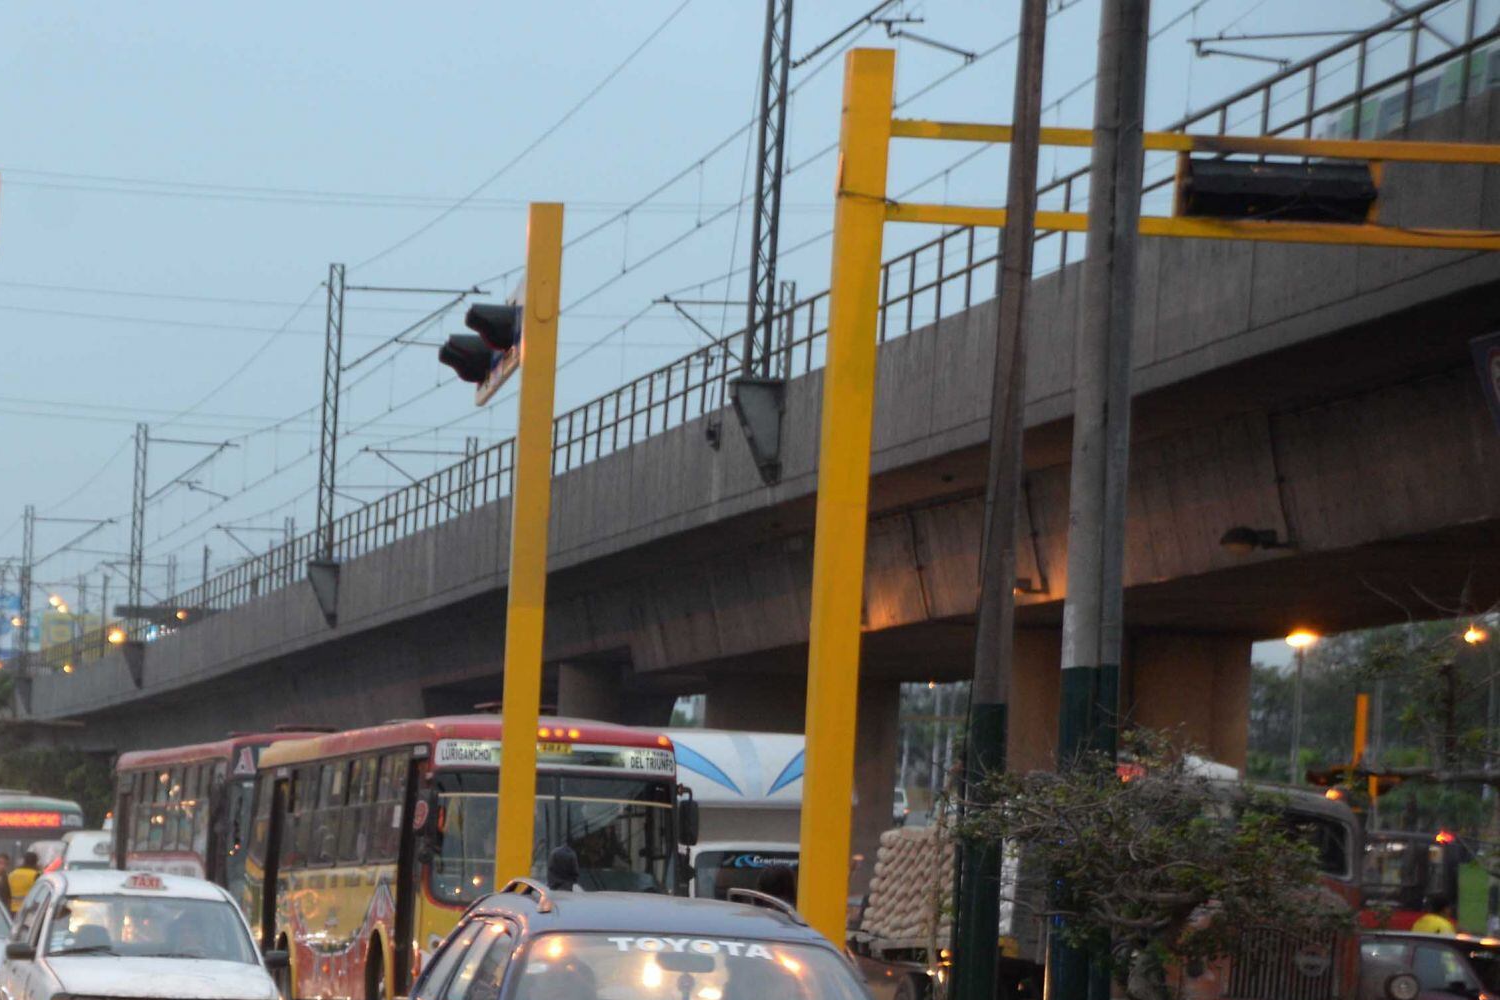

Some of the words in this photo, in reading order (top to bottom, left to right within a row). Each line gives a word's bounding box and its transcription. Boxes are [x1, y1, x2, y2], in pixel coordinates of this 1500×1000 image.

[441, 748, 490, 761] LURIGANCHO
[630, 756, 644, 769] DEL
[646, 757, 675, 772] TRIUNFO
[131, 876, 160, 889] TAXI
[607, 937, 773, 960] TOYOTA
